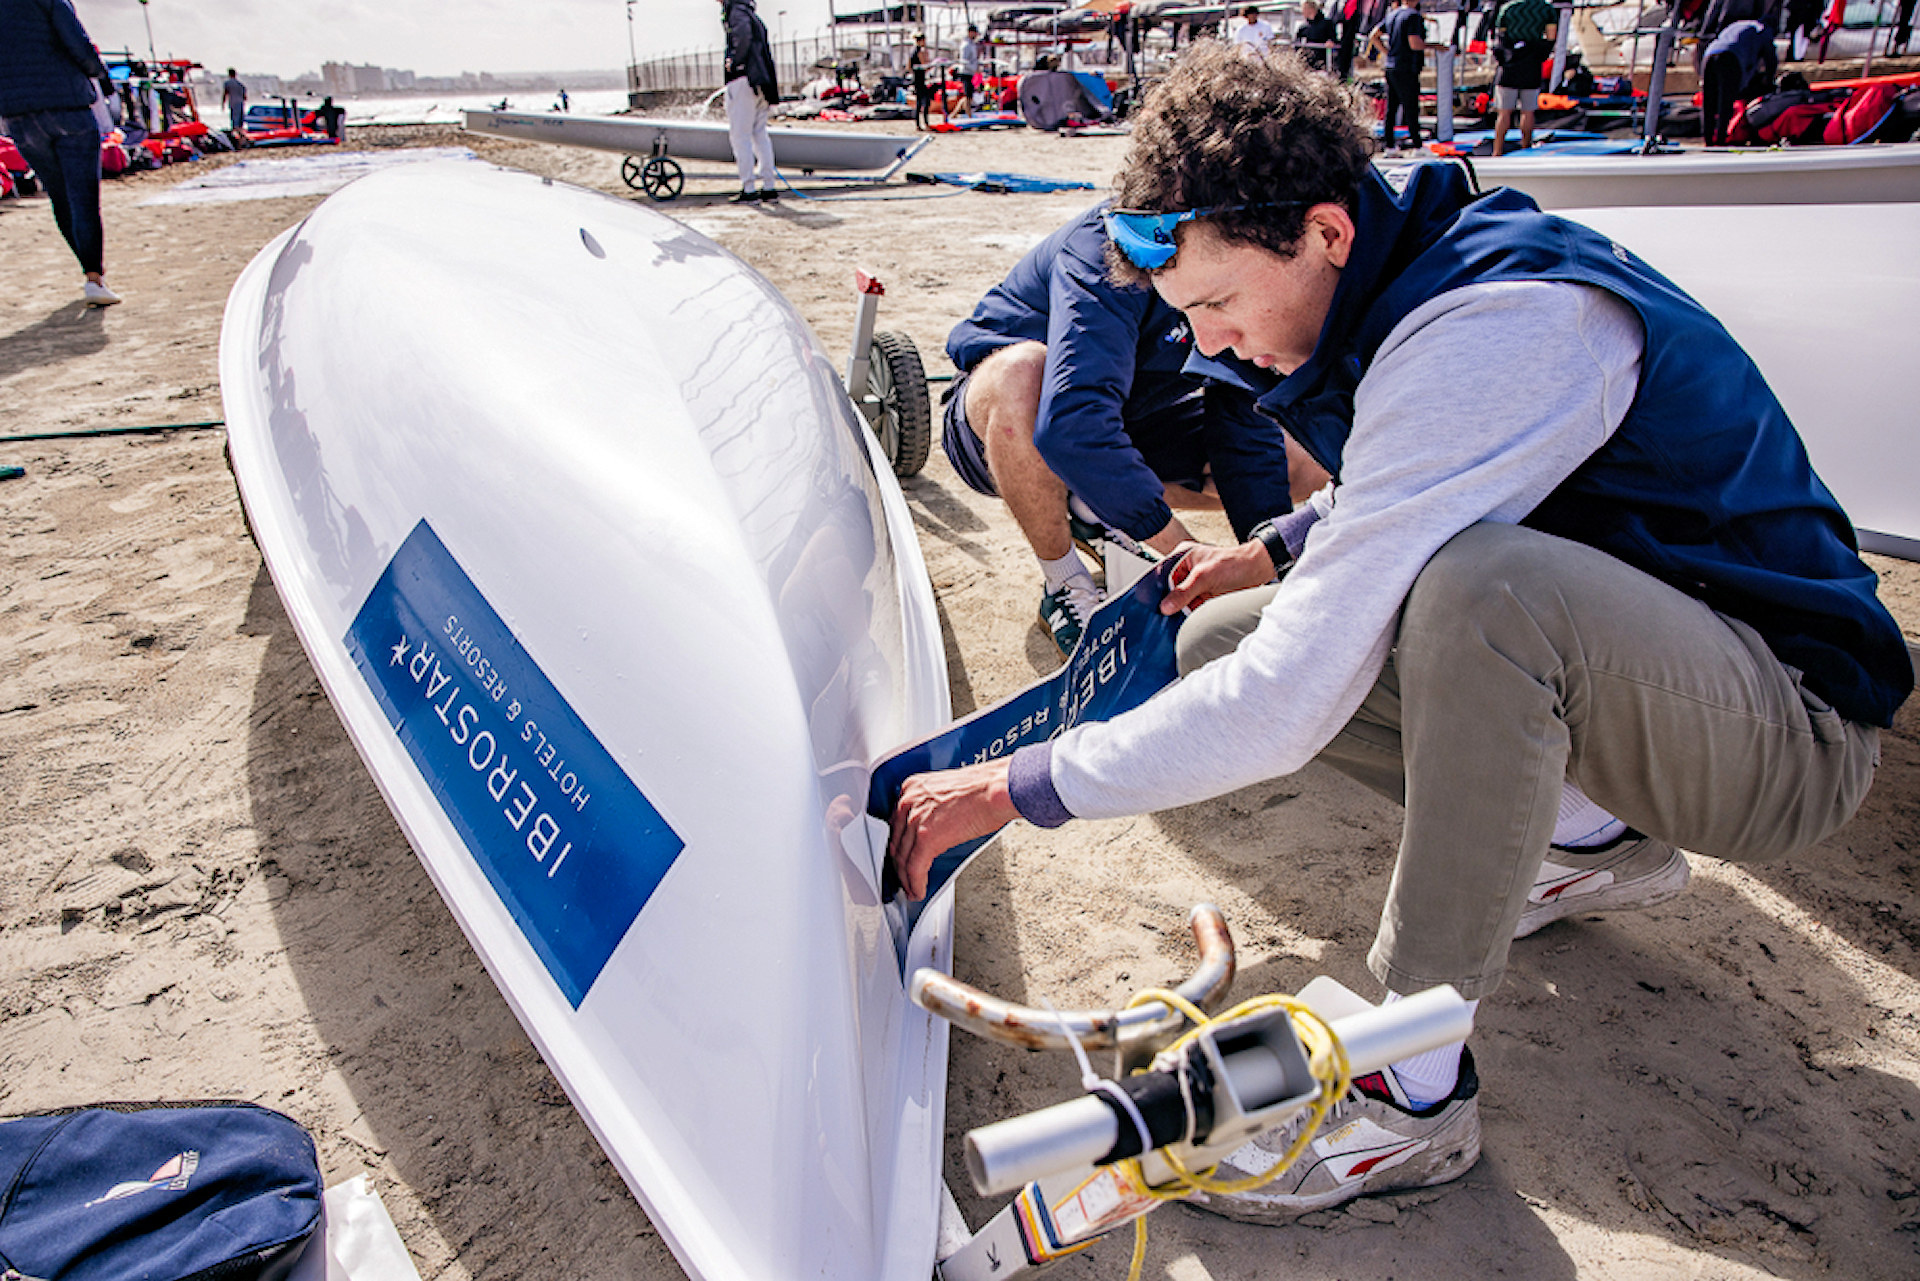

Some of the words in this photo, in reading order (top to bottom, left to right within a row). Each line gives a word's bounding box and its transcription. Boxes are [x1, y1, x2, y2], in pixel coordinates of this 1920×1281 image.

[443, 615, 508, 702] RESORTS
[506, 698, 522, 722] &
[960, 706, 1051, 767] RESOR
[408, 640, 573, 878] IBEROSTAR
[521, 720, 591, 812] HOTELS
